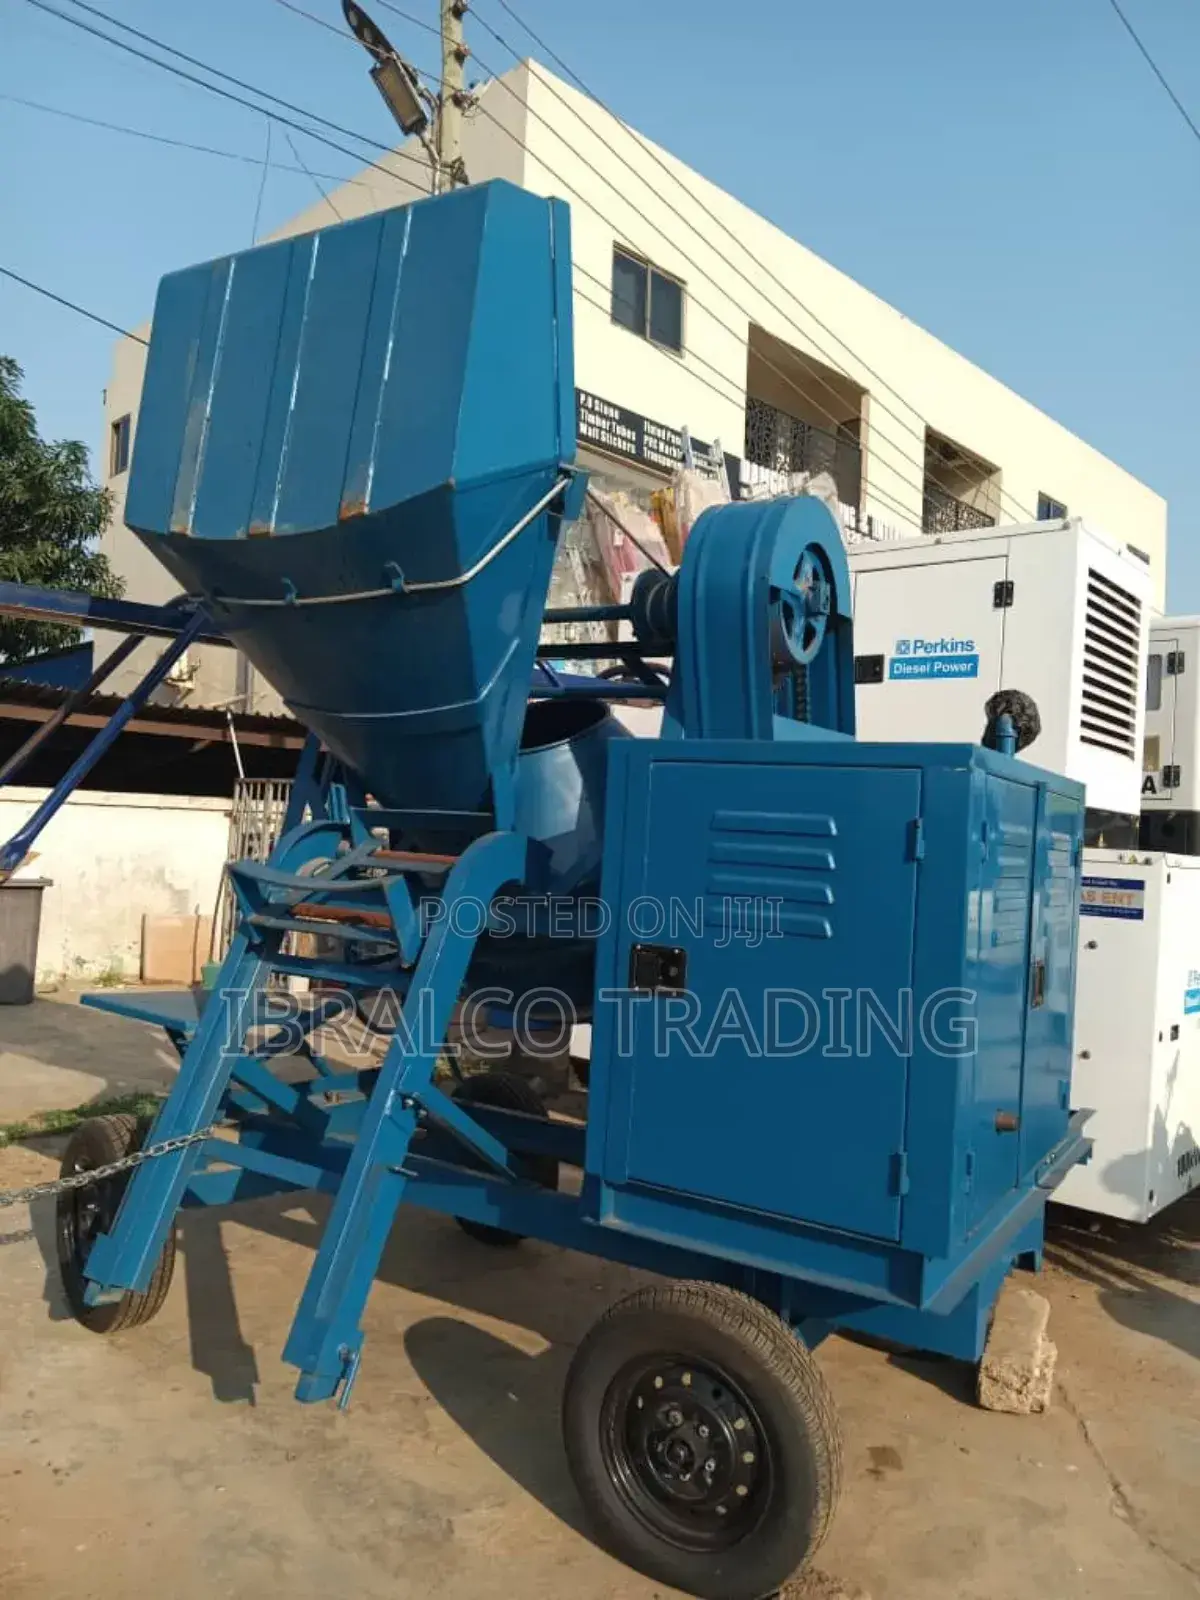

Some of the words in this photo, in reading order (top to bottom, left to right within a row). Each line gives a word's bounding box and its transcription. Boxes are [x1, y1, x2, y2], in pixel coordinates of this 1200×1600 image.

[913, 637, 975, 655] Perkins
[893, 662, 930, 674] Diesel
[933, 661, 974, 673] Power
